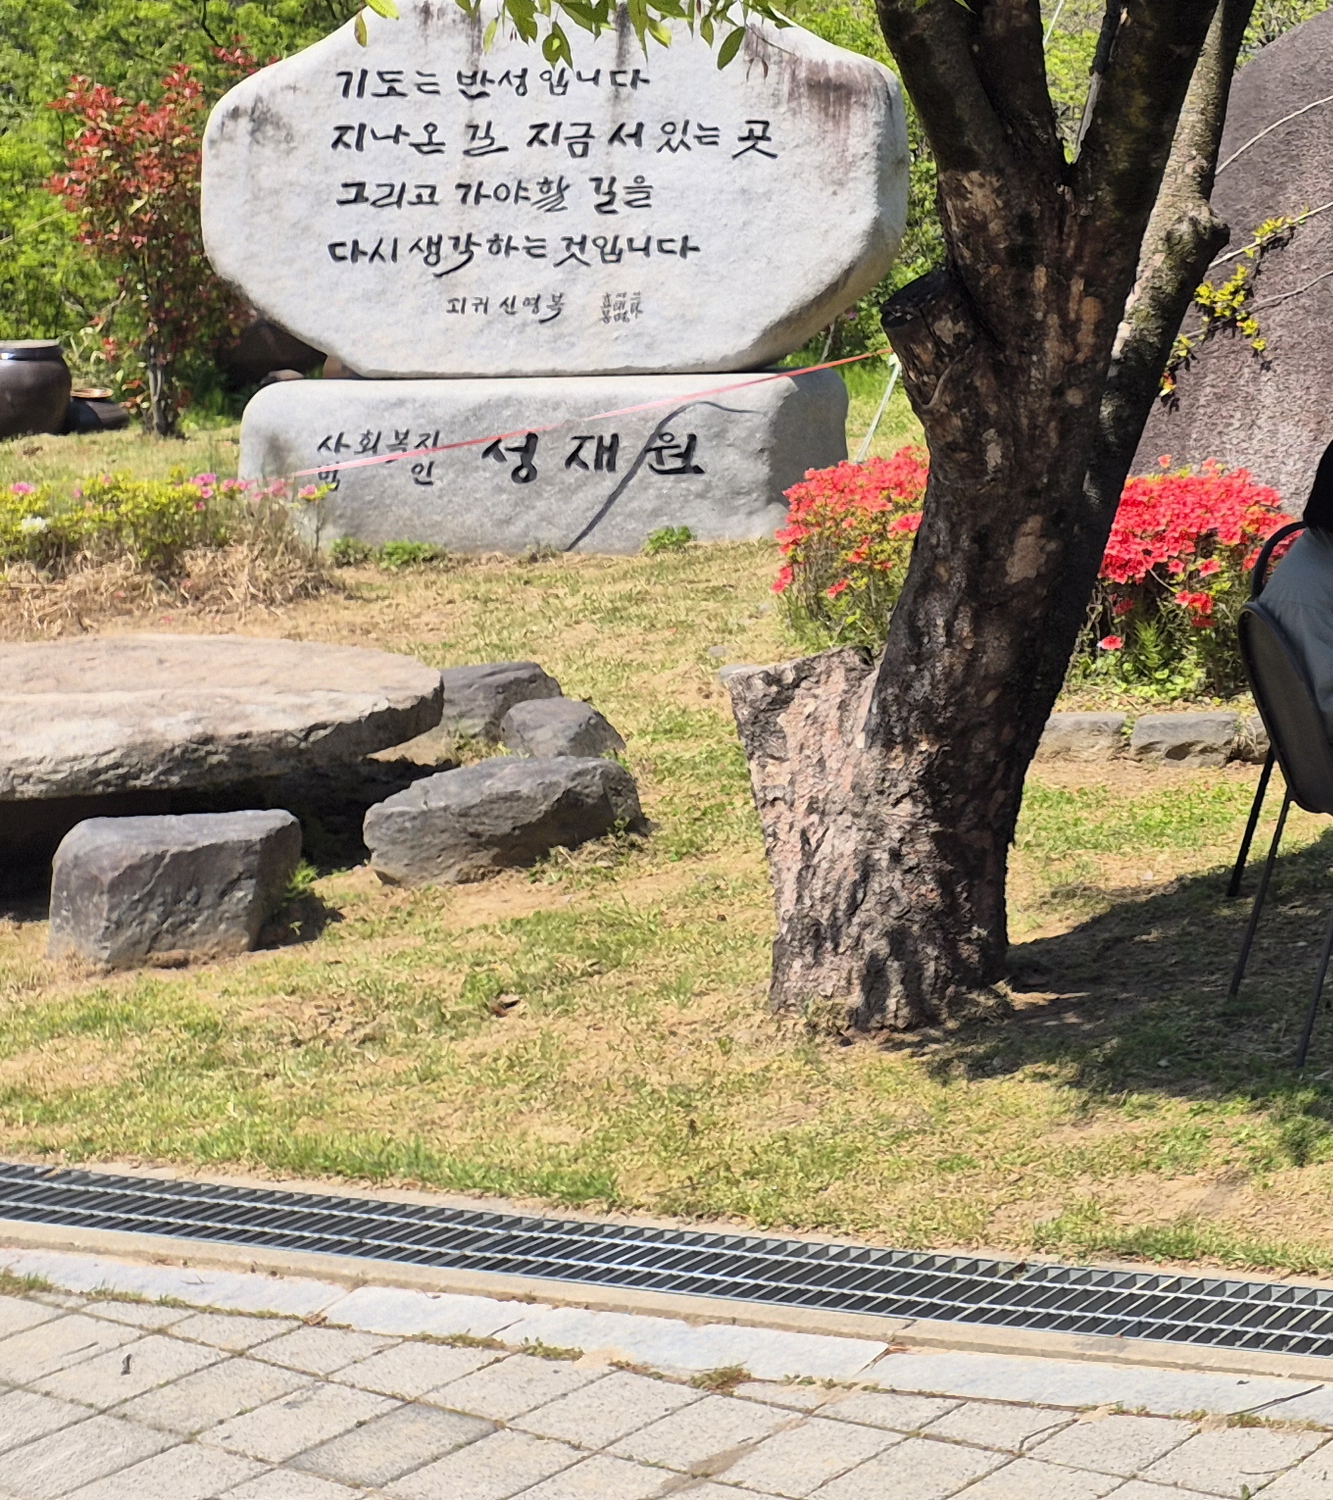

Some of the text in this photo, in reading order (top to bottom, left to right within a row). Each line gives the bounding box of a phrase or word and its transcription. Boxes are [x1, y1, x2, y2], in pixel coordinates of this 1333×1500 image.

[336, 67, 651, 100] 기도는 반성입니다
[331, 121, 446, 154] 지나온
[462, 120, 509, 156] 길
[526, 120, 596, 159] 지금
[731, 119, 779, 160] 곳
[336, 174, 654, 215] 그리고 가야할 길을
[327, 232, 701, 279] 다시 생각하는 것입니다
[316, 428, 440, 464] 사회복지
[481, 431, 705, 485] 성재원
